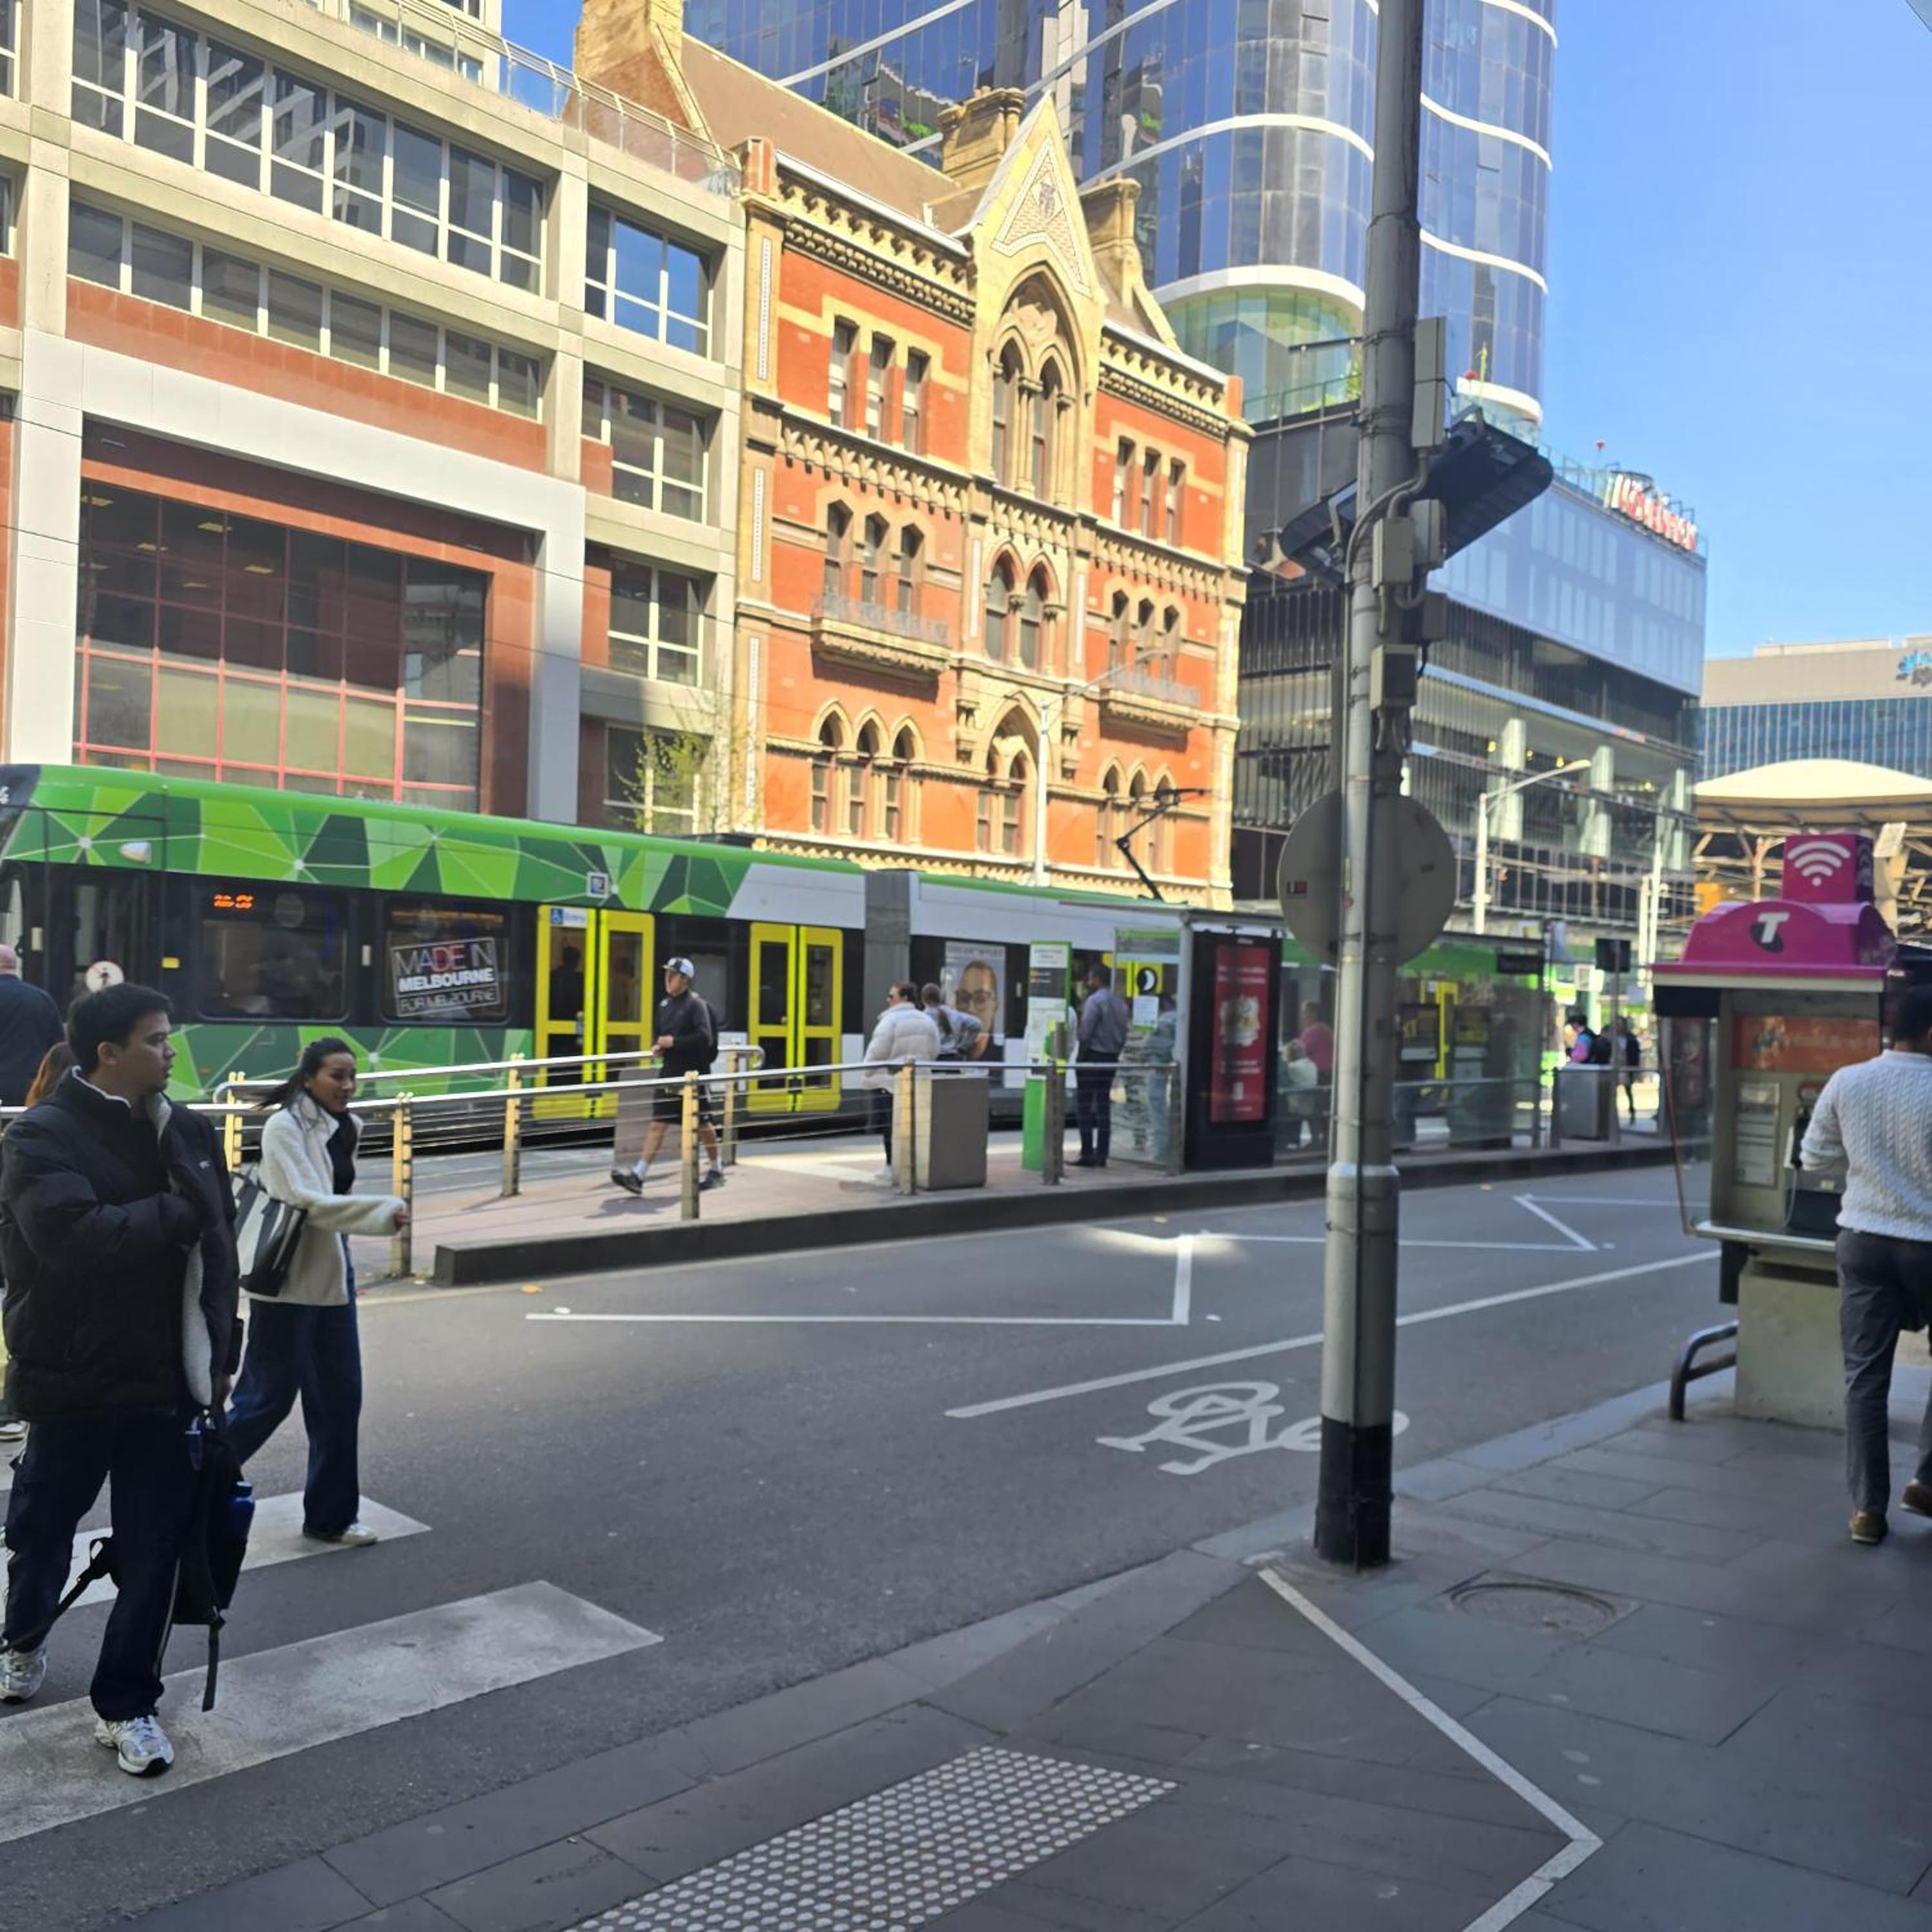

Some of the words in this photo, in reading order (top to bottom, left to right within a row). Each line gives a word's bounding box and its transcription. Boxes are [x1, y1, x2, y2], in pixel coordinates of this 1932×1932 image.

[1758, 912, 1790, 943] T
[392, 945, 466, 976] MADE
[398, 968, 495, 992] MELBOURNE
